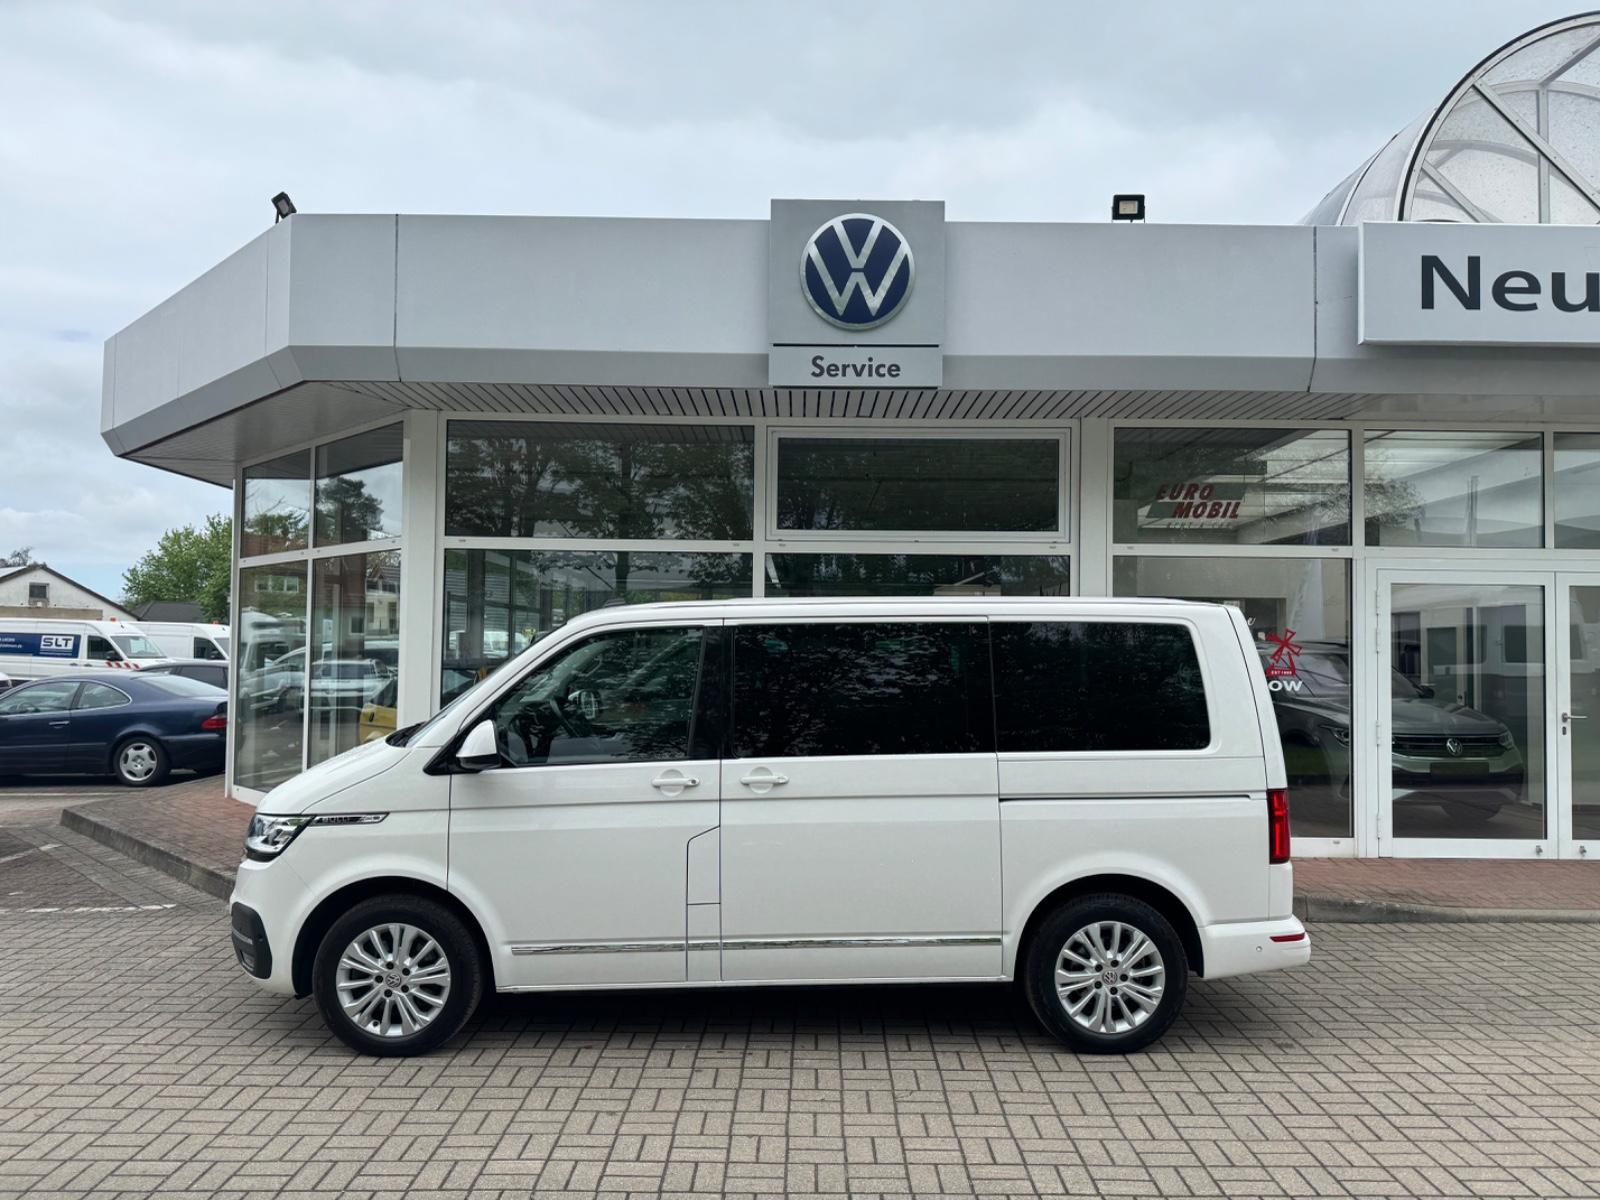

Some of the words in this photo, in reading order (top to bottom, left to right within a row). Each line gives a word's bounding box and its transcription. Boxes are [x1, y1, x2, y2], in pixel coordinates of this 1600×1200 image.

[1421, 255, 1600, 313] Neu
[811, 355, 901, 378] Service
[1156, 483, 1215, 501] EURO
[1173, 501, 1241, 519] MOBIL
[42, 637, 72, 648] SLT
